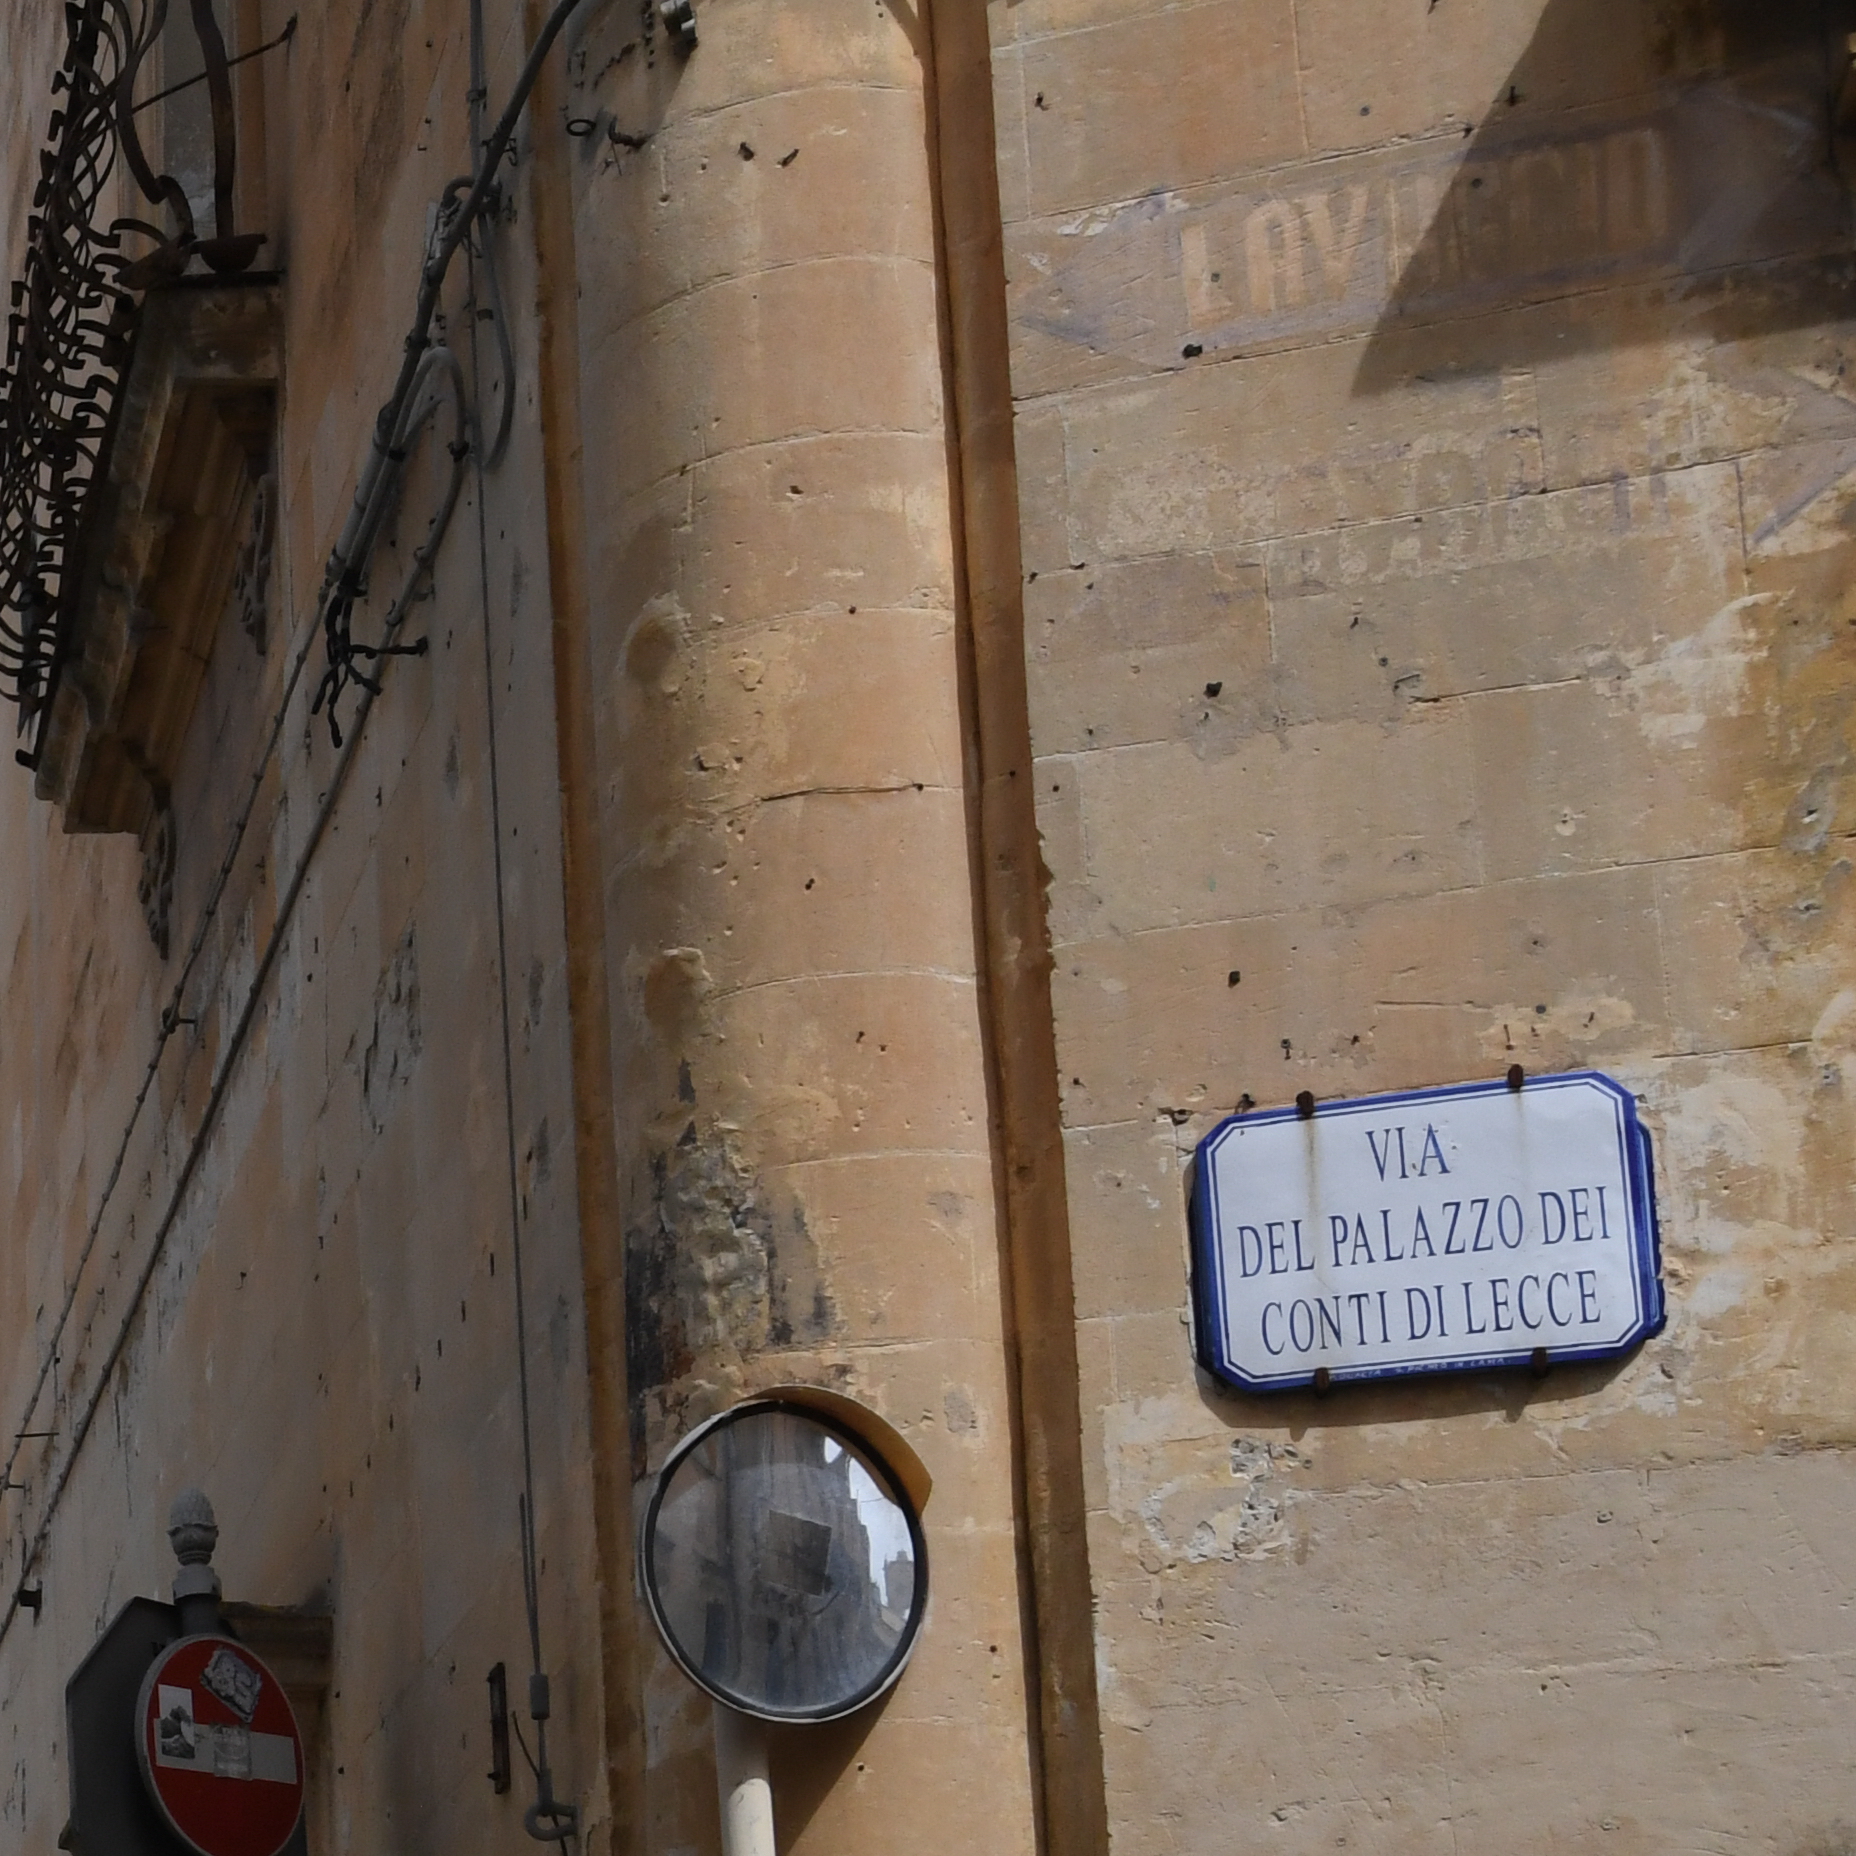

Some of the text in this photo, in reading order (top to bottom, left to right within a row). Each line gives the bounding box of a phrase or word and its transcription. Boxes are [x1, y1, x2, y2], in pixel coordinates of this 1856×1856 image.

[1365, 1123, 1451, 1182] VIA
[1237, 1186, 1612, 1279] DEL PALAZZO DEI
[1260, 1269, 1602, 1356] CONTI DI LECCE
